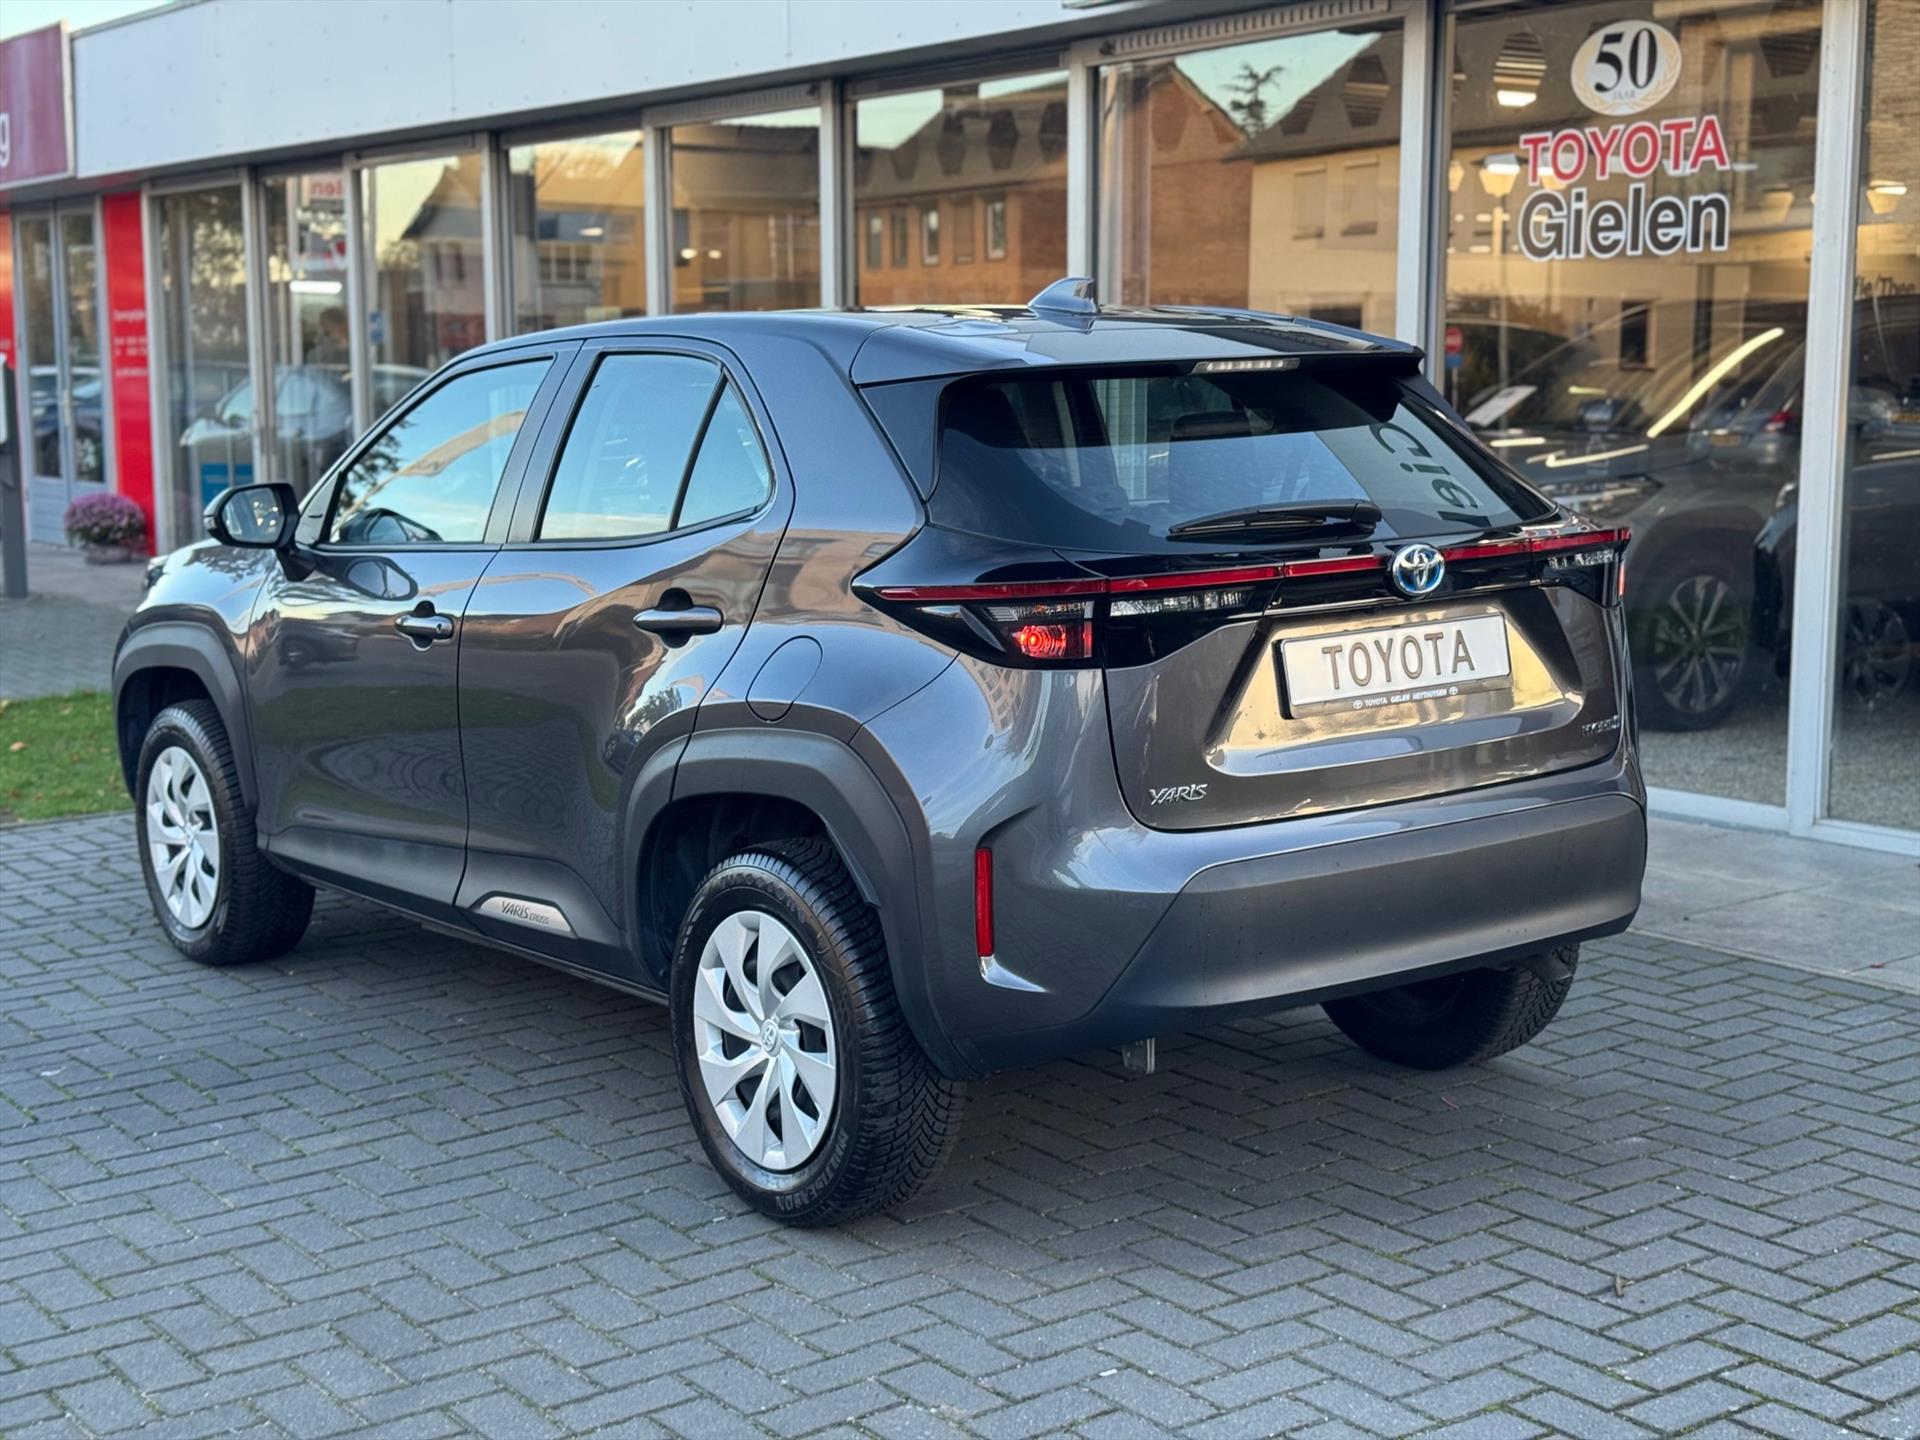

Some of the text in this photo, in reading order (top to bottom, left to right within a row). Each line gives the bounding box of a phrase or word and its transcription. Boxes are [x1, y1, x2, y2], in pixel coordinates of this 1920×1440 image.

[1594, 27, 1658, 93] 50
[1519, 114, 1732, 187] TOYOTA
[1518, 182, 1730, 262] Gielen
[1322, 630, 1475, 690] TOYOTA
[1364, 698, 1388, 707] TOYOTA
[1149, 783, 1208, 806] YARIS
[502, 900, 530, 920] YARIS
